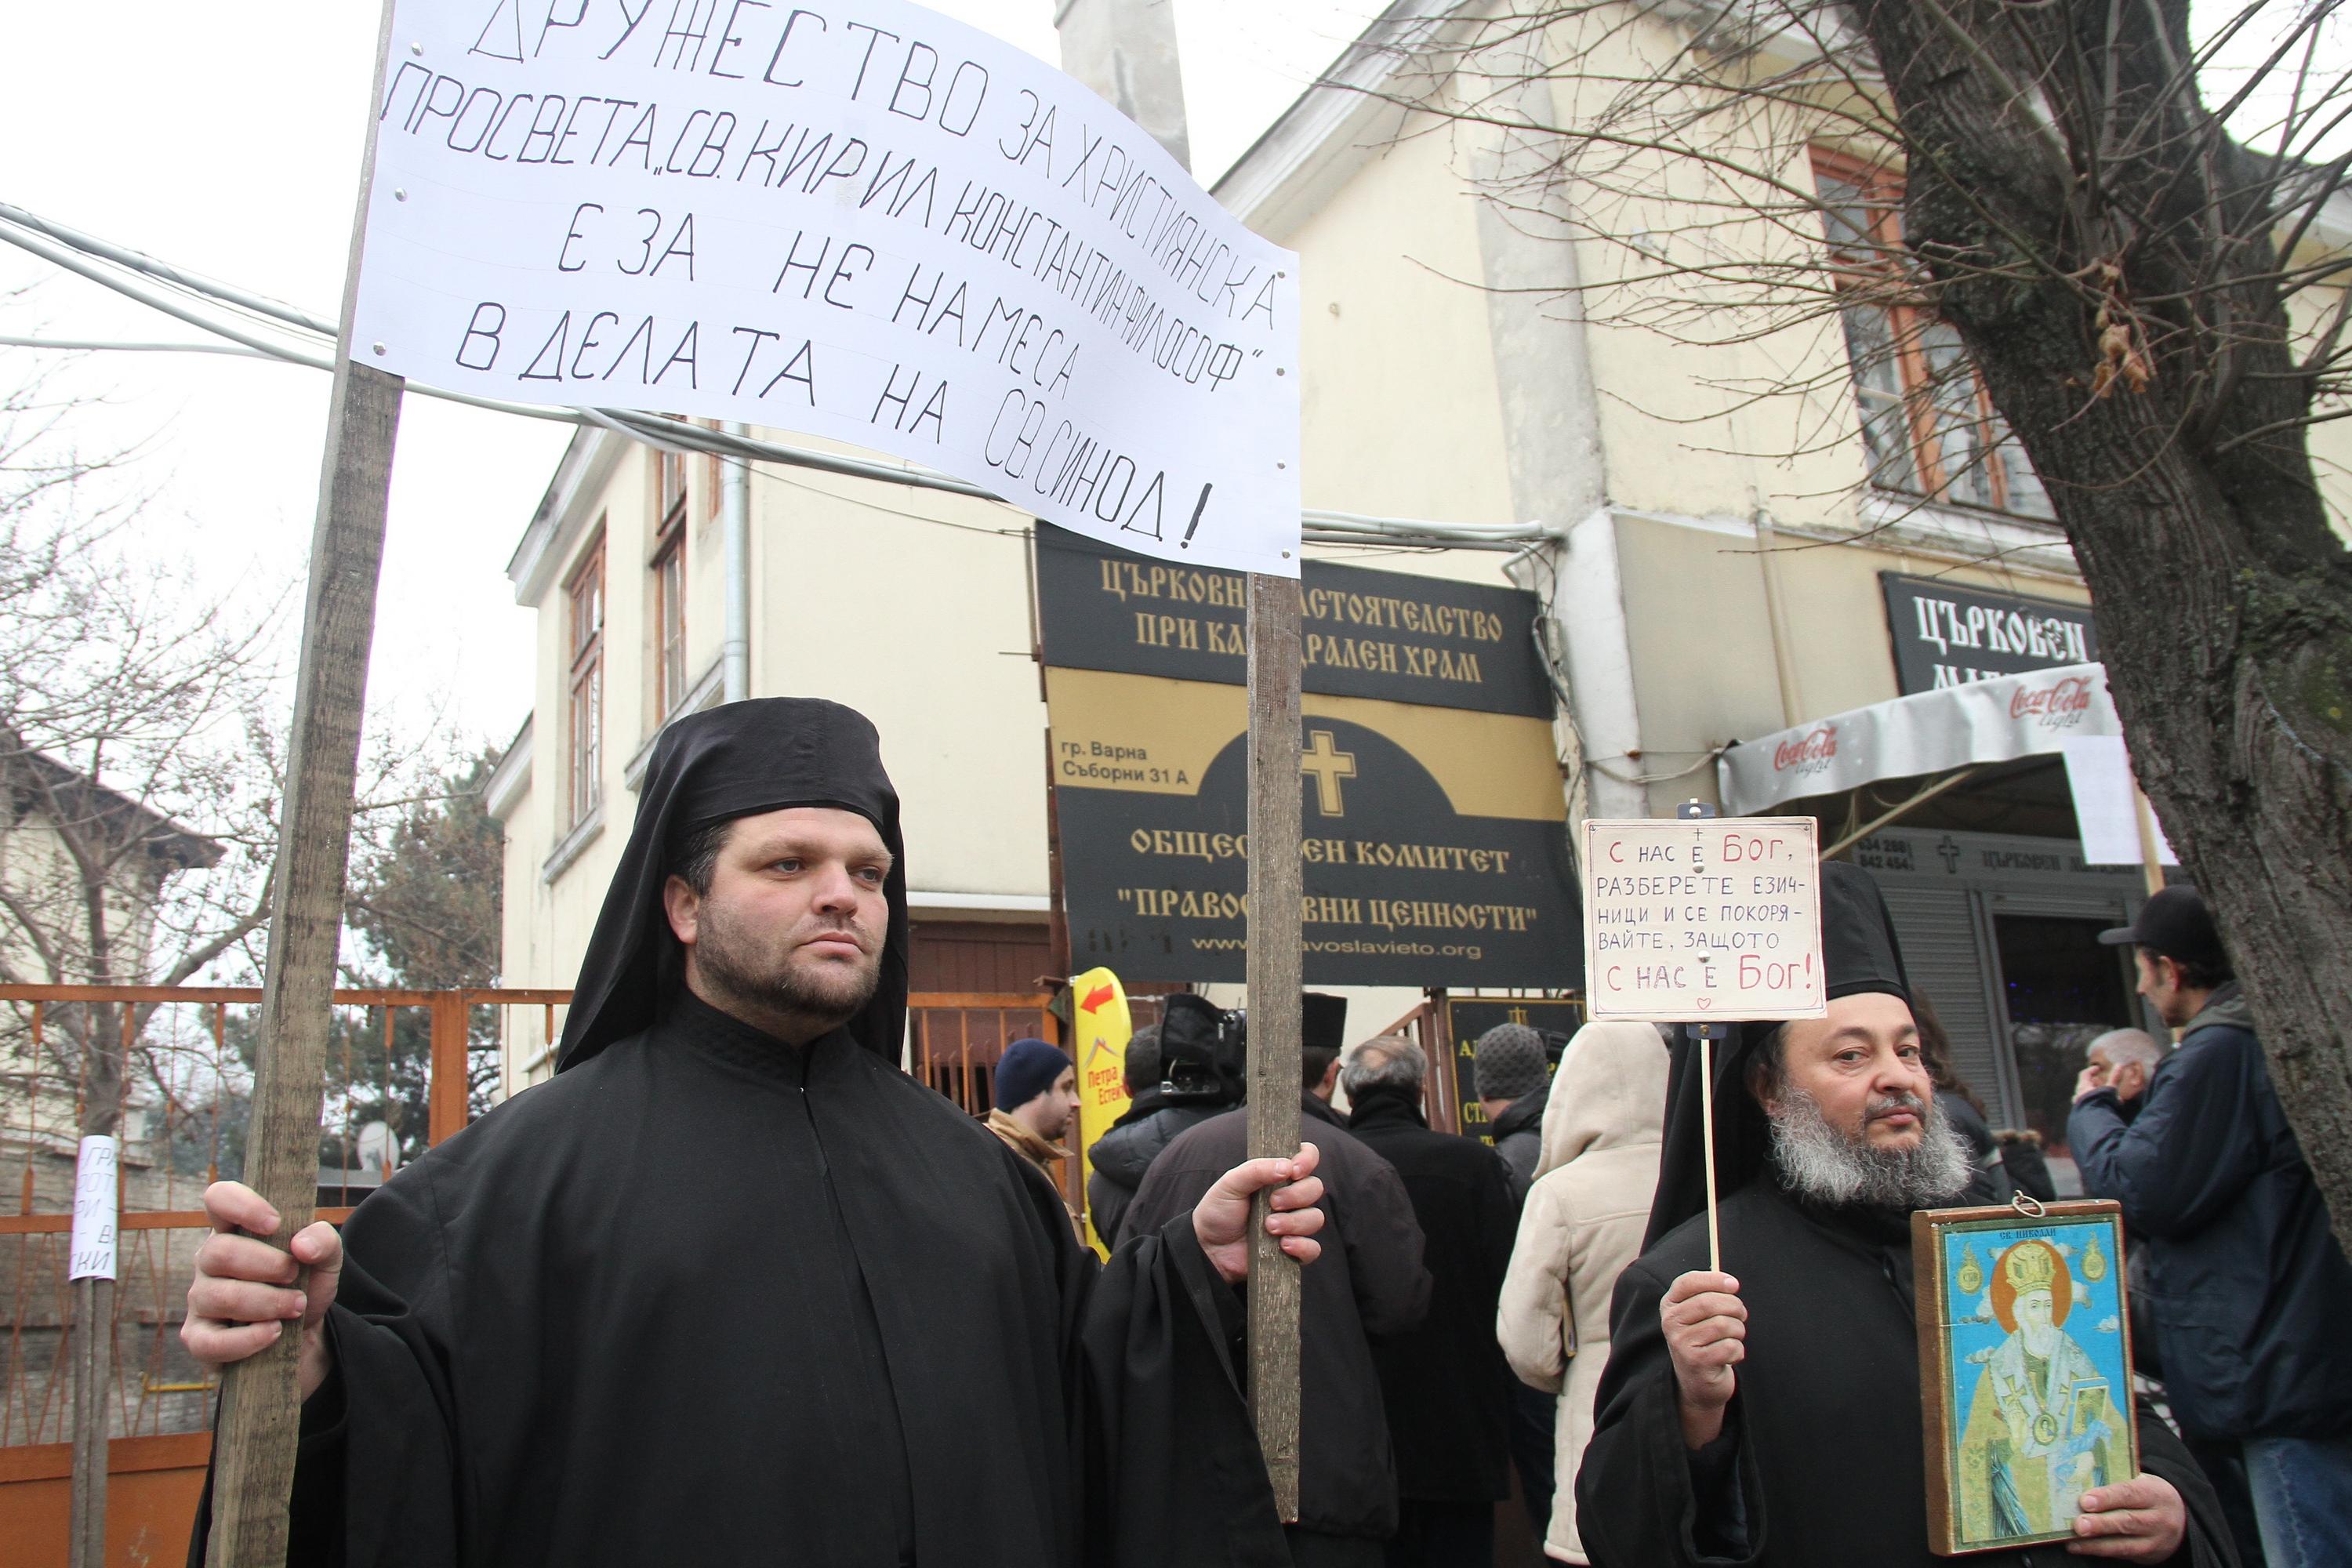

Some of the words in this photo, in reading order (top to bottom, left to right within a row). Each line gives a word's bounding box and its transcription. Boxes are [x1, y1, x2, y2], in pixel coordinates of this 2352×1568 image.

[468, 0, 989, 136] ДРУЖЕСТВО
[999, 89, 1056, 179] ЗА
[1062, 123, 1277, 330] ХРИСТИЯНСКА
[737, 119, 937, 227] КИРИЛ
[558, 203, 604, 272] Е
[617, 208, 695, 281] ЗА
[772, 230, 875, 310] НЕ
[456, 302, 506, 371] В
[871, 364, 948, 445] НА
[1099, 559, 1248, 609] ЦЪРКОВН
[1300, 586, 1504, 644] СТОЯТЕЛСТВО
[1135, 612, 1200, 651] ПРИ
[1205, 620, 1399, 675] КАРАЛЕН
[1403, 644, 1484, 684] ХРАМ
[1912, 595, 2090, 664] ЦЪРКОВЕН
[1061, 742, 1087, 758] гр.
[1091, 741, 1147, 761] Варна
[1063, 760, 1145, 782] Съборни
[1150, 768, 1170, 783] 31
[1131, 828, 1346, 863] ОБЩЕСЕН
[1356, 841, 1510, 874] КОМИТЕТ
[1609, 841, 1625, 863] С
[1639, 845, 1675, 862] НАС
[1117, 888, 1363, 924] "ПРАВОВНИ
[1597, 877, 1734, 898] РАЗБЕРЕТЕ
[1598, 907, 1649, 926] НИЦИ
[1664, 906, 1675, 922] И
[1685, 906, 1708, 922] СЕ
[1684, 931, 1780, 951] ЗАЩОТО
[1607, 965, 1622, 991] С
[1636, 965, 1686, 989] НАС
[1704, 966, 1718, 989] Е
